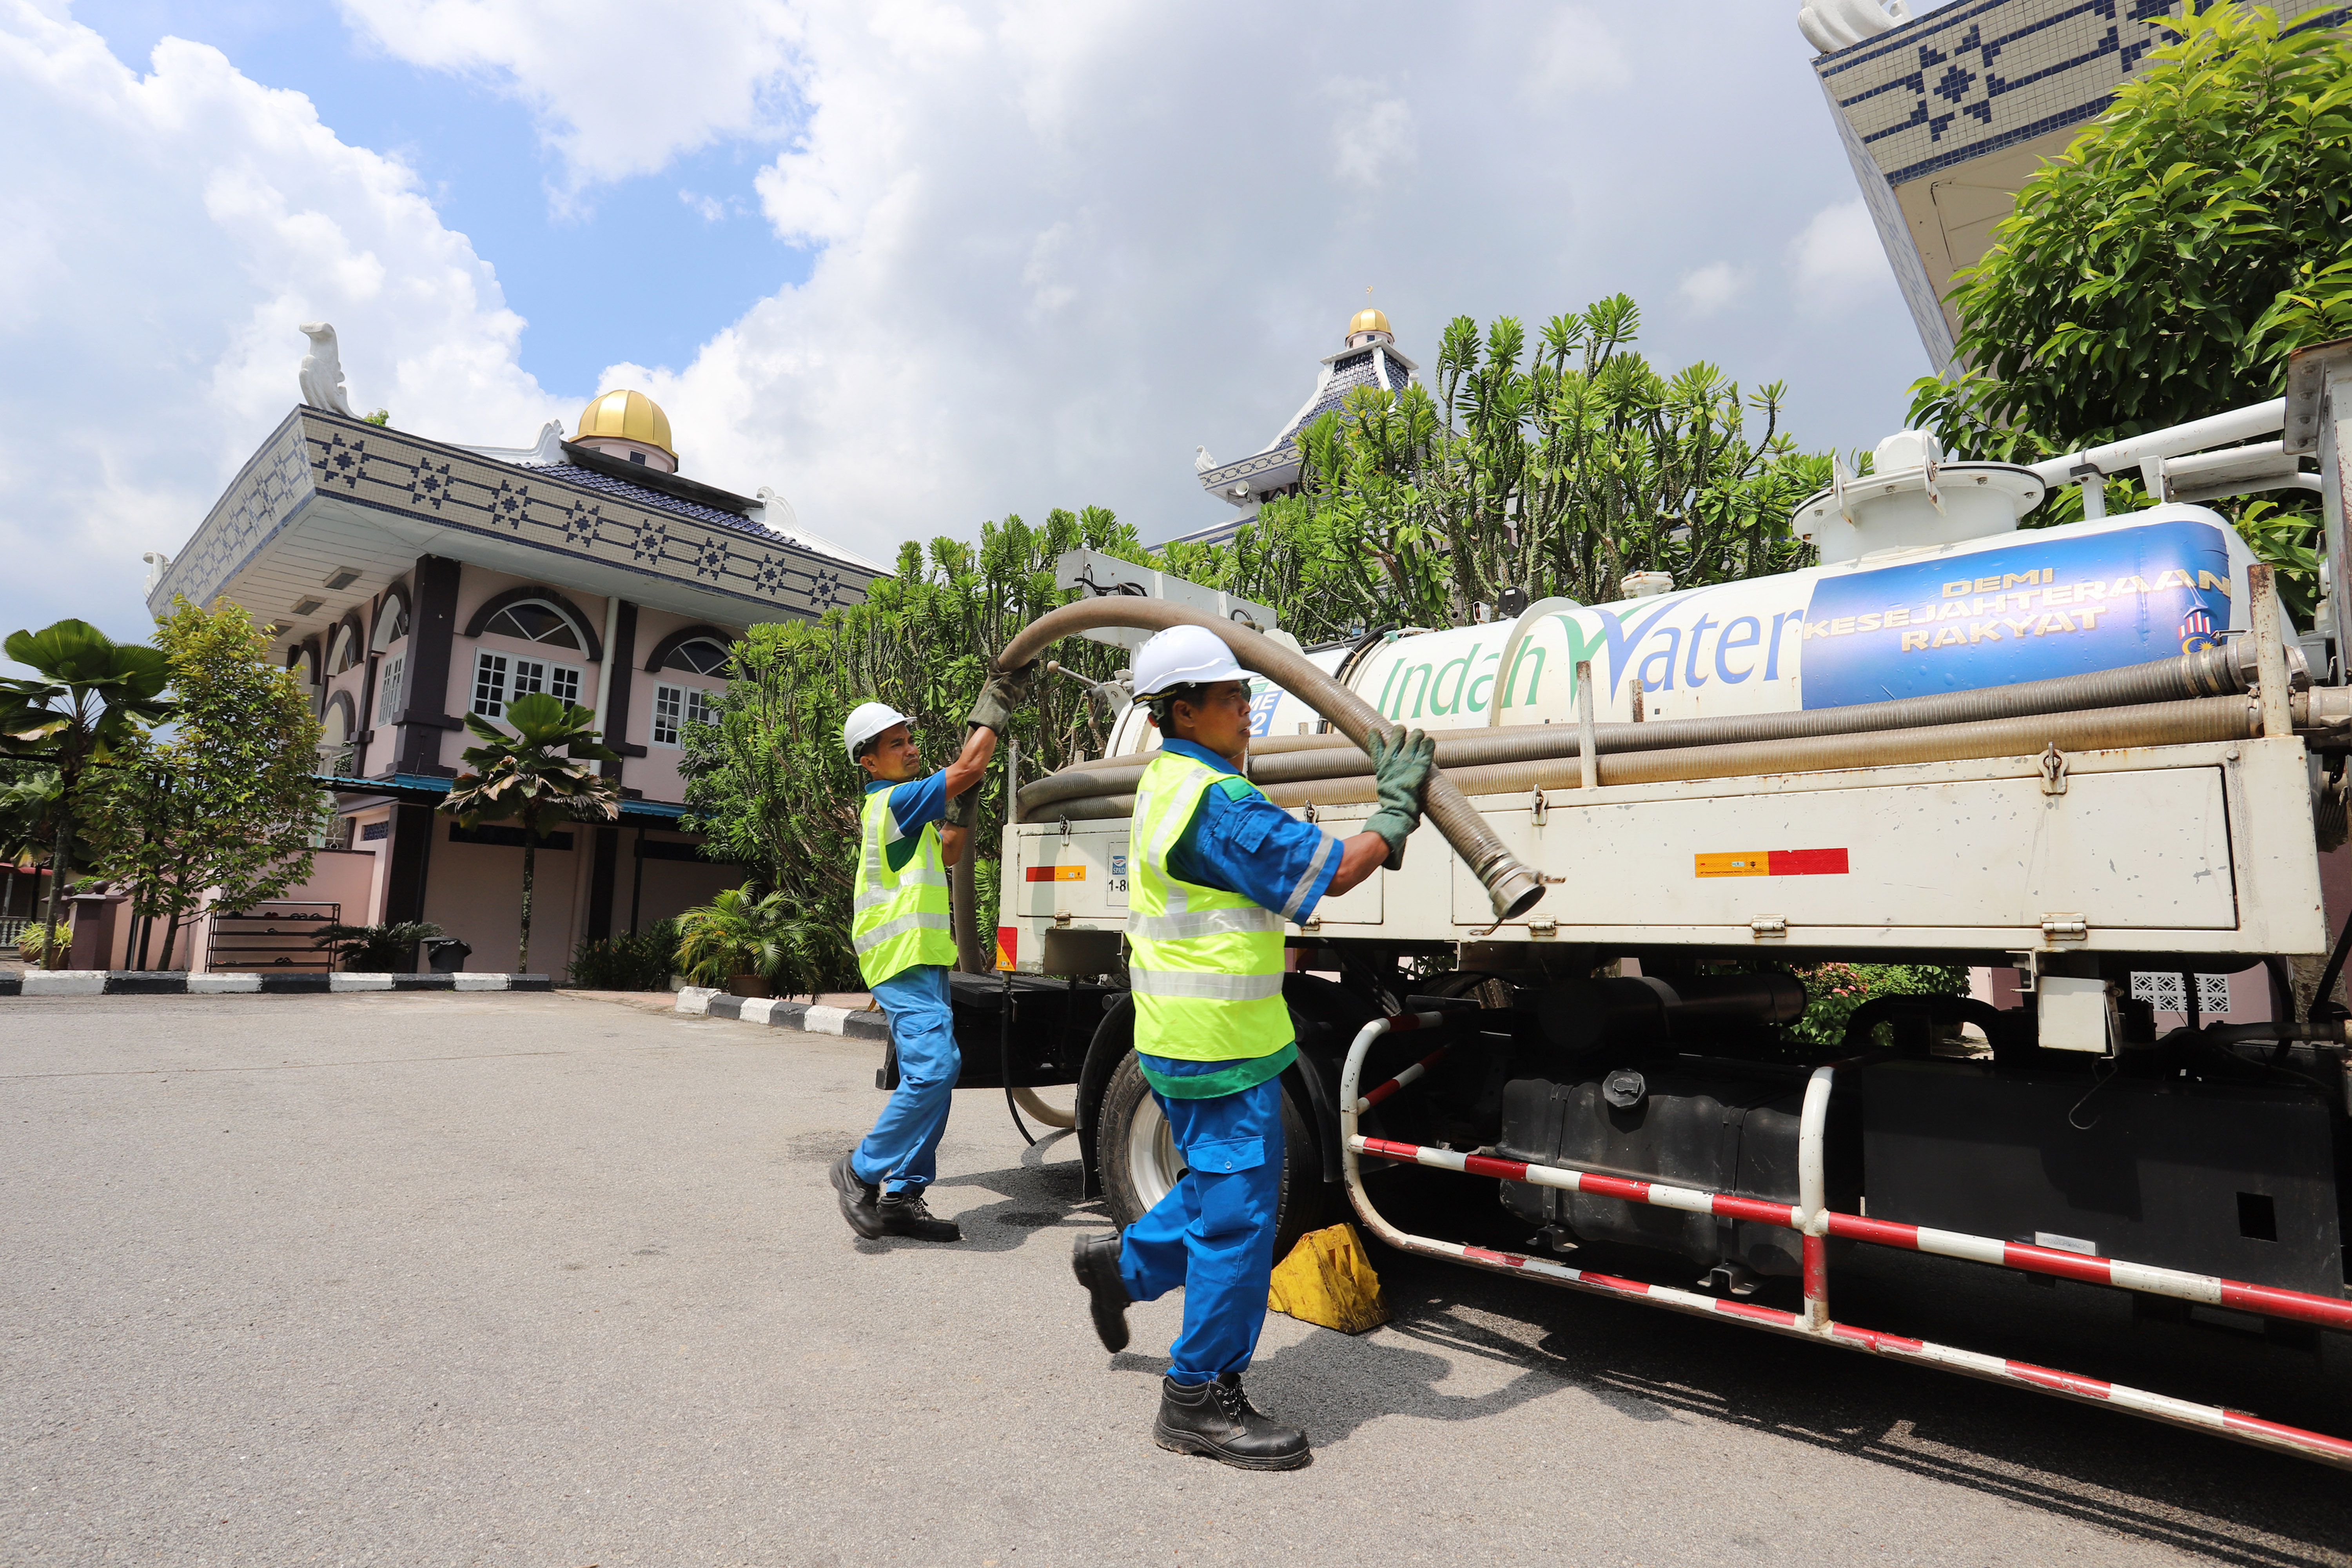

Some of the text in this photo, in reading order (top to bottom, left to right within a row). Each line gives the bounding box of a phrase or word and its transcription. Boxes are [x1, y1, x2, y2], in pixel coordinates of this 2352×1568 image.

[1803, 569, 2230, 639] KESEJAHTERAAN
[1942, 568, 2053, 598] DEMI
[1902, 606, 2106, 651] RAKYAT
[1377, 586, 1804, 720] Indah Water
[1109, 879, 1129, 892] 1-8
